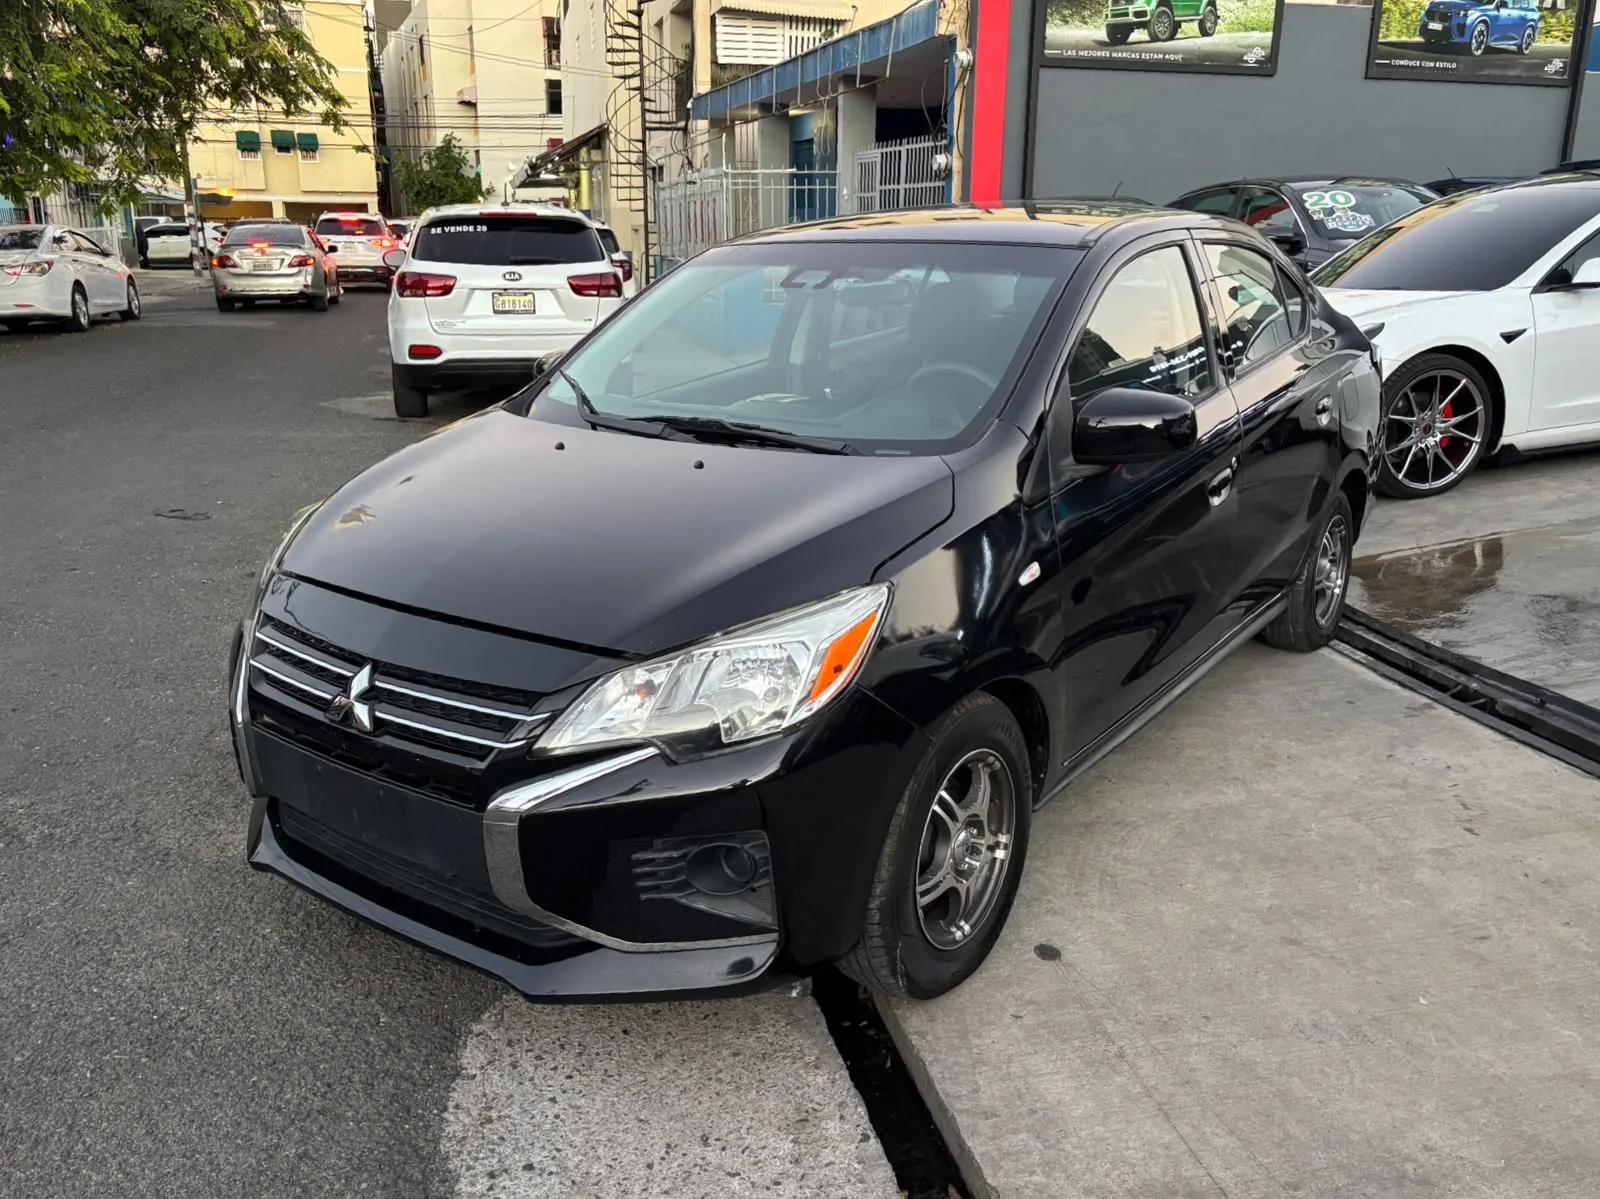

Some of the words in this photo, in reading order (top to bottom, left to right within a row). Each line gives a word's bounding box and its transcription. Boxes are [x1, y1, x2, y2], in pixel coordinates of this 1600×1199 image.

[1111, 51, 1140, 59] MARCAS
[1391, 59, 1421, 67] CONDUCE
[1421, 60, 1435, 68] CON
[1436, 61, 1457, 69] ESTILO
[1302, 190, 1356, 210] 20
[430, 227, 442, 235] SE
[444, 225, 475, 233] VENDE
[476, 224, 488, 233] 20
[504, 272, 521, 281] KIA
